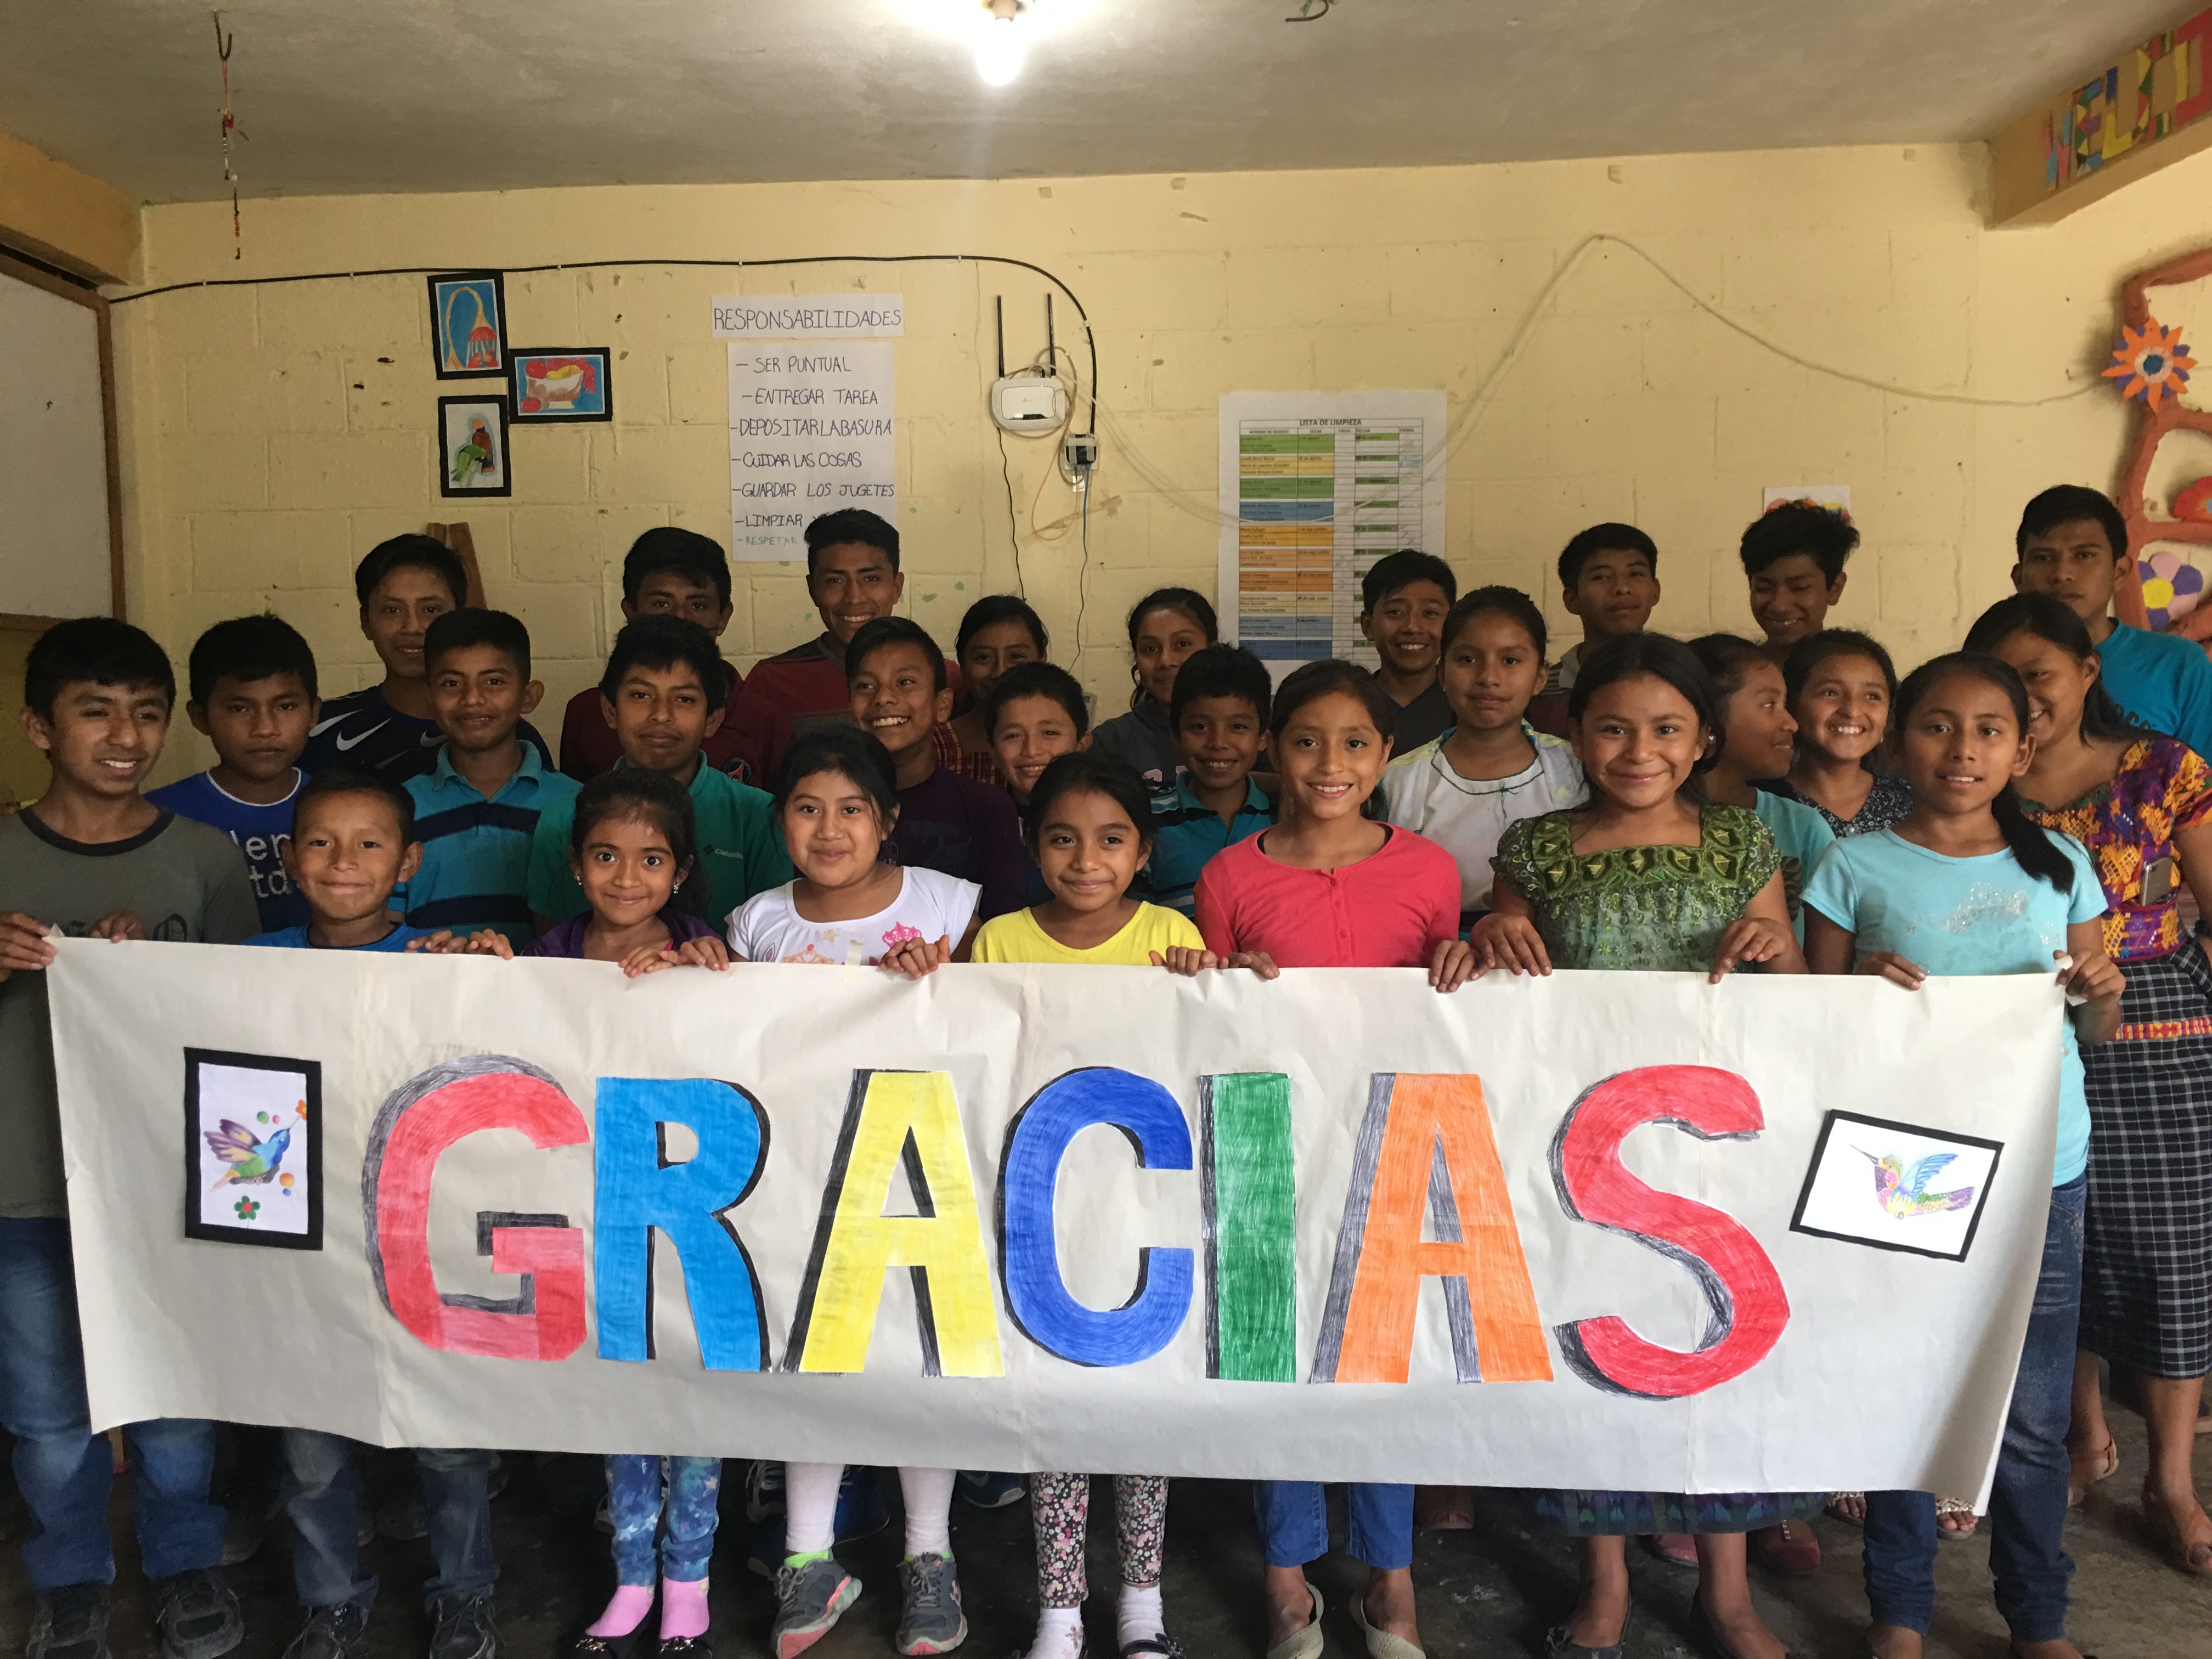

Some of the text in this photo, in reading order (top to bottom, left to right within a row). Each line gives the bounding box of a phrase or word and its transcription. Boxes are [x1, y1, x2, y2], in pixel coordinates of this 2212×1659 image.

[714, 308, 902, 330] RESPONSABILIDADES
[753, 356, 851, 374] SER PUNTUAL
[755, 388, 878, 405] ENTREGAR TAREA
[742, 451, 862, 468] CUIDAR LAS COSAS
[741, 482, 894, 498] GUARDAR LOS JUGETES
[745, 514, 803, 527] LIMPIAR
[746, 535, 798, 546] RESPETAR
[361, 1052, 1791, 1400] GRACIAS
